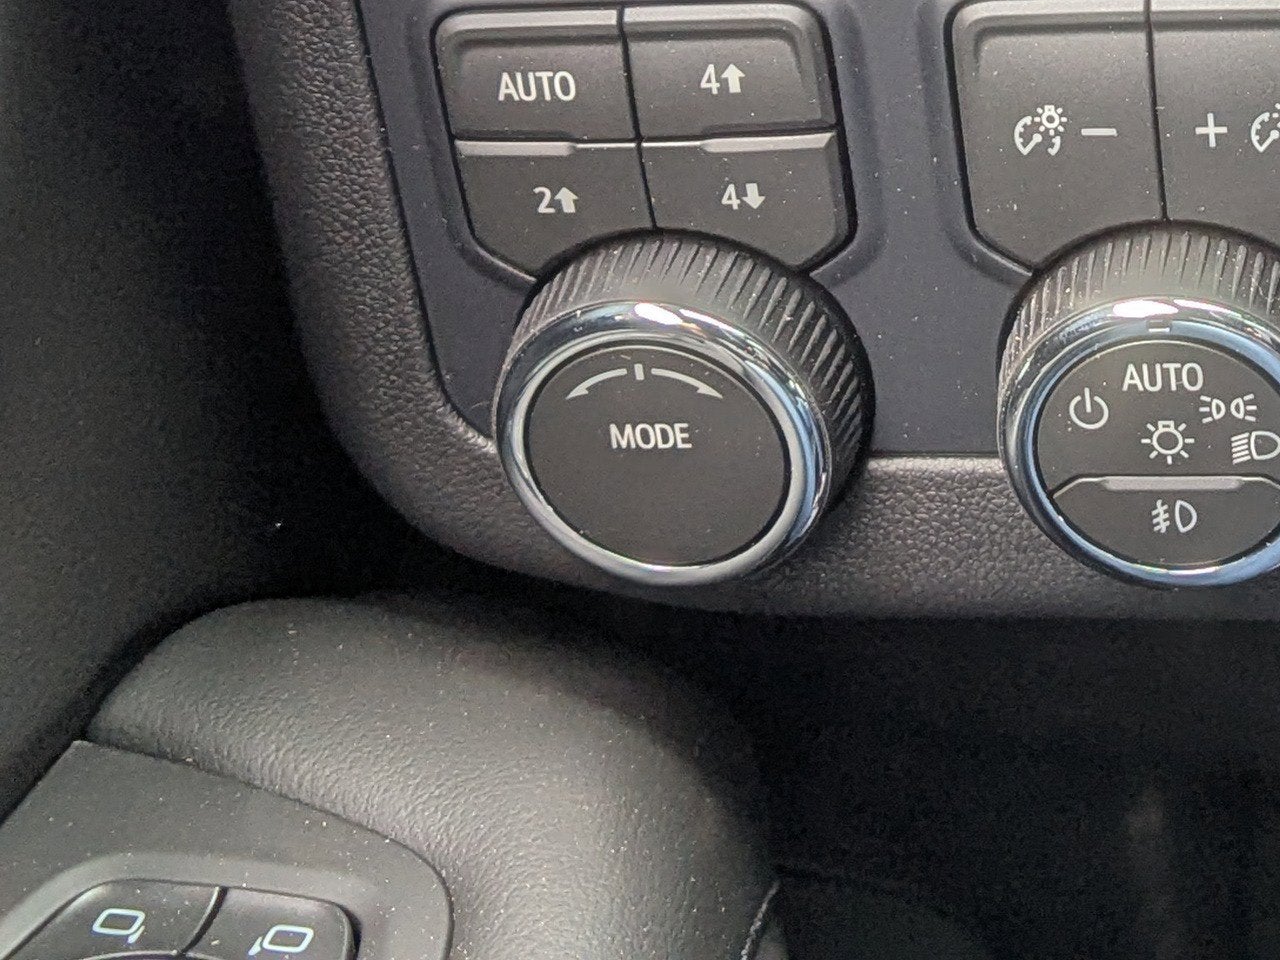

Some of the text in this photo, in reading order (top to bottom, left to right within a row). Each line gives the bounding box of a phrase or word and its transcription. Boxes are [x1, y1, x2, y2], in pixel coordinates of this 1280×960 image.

[498, 70, 576, 102] AUTO
[699, 63, 721, 95] 4
[532, 186, 555, 214] 2
[720, 183, 741, 210] 4
[1121, 361, 1204, 393] AUTO
[608, 421, 693, 450] MODE
